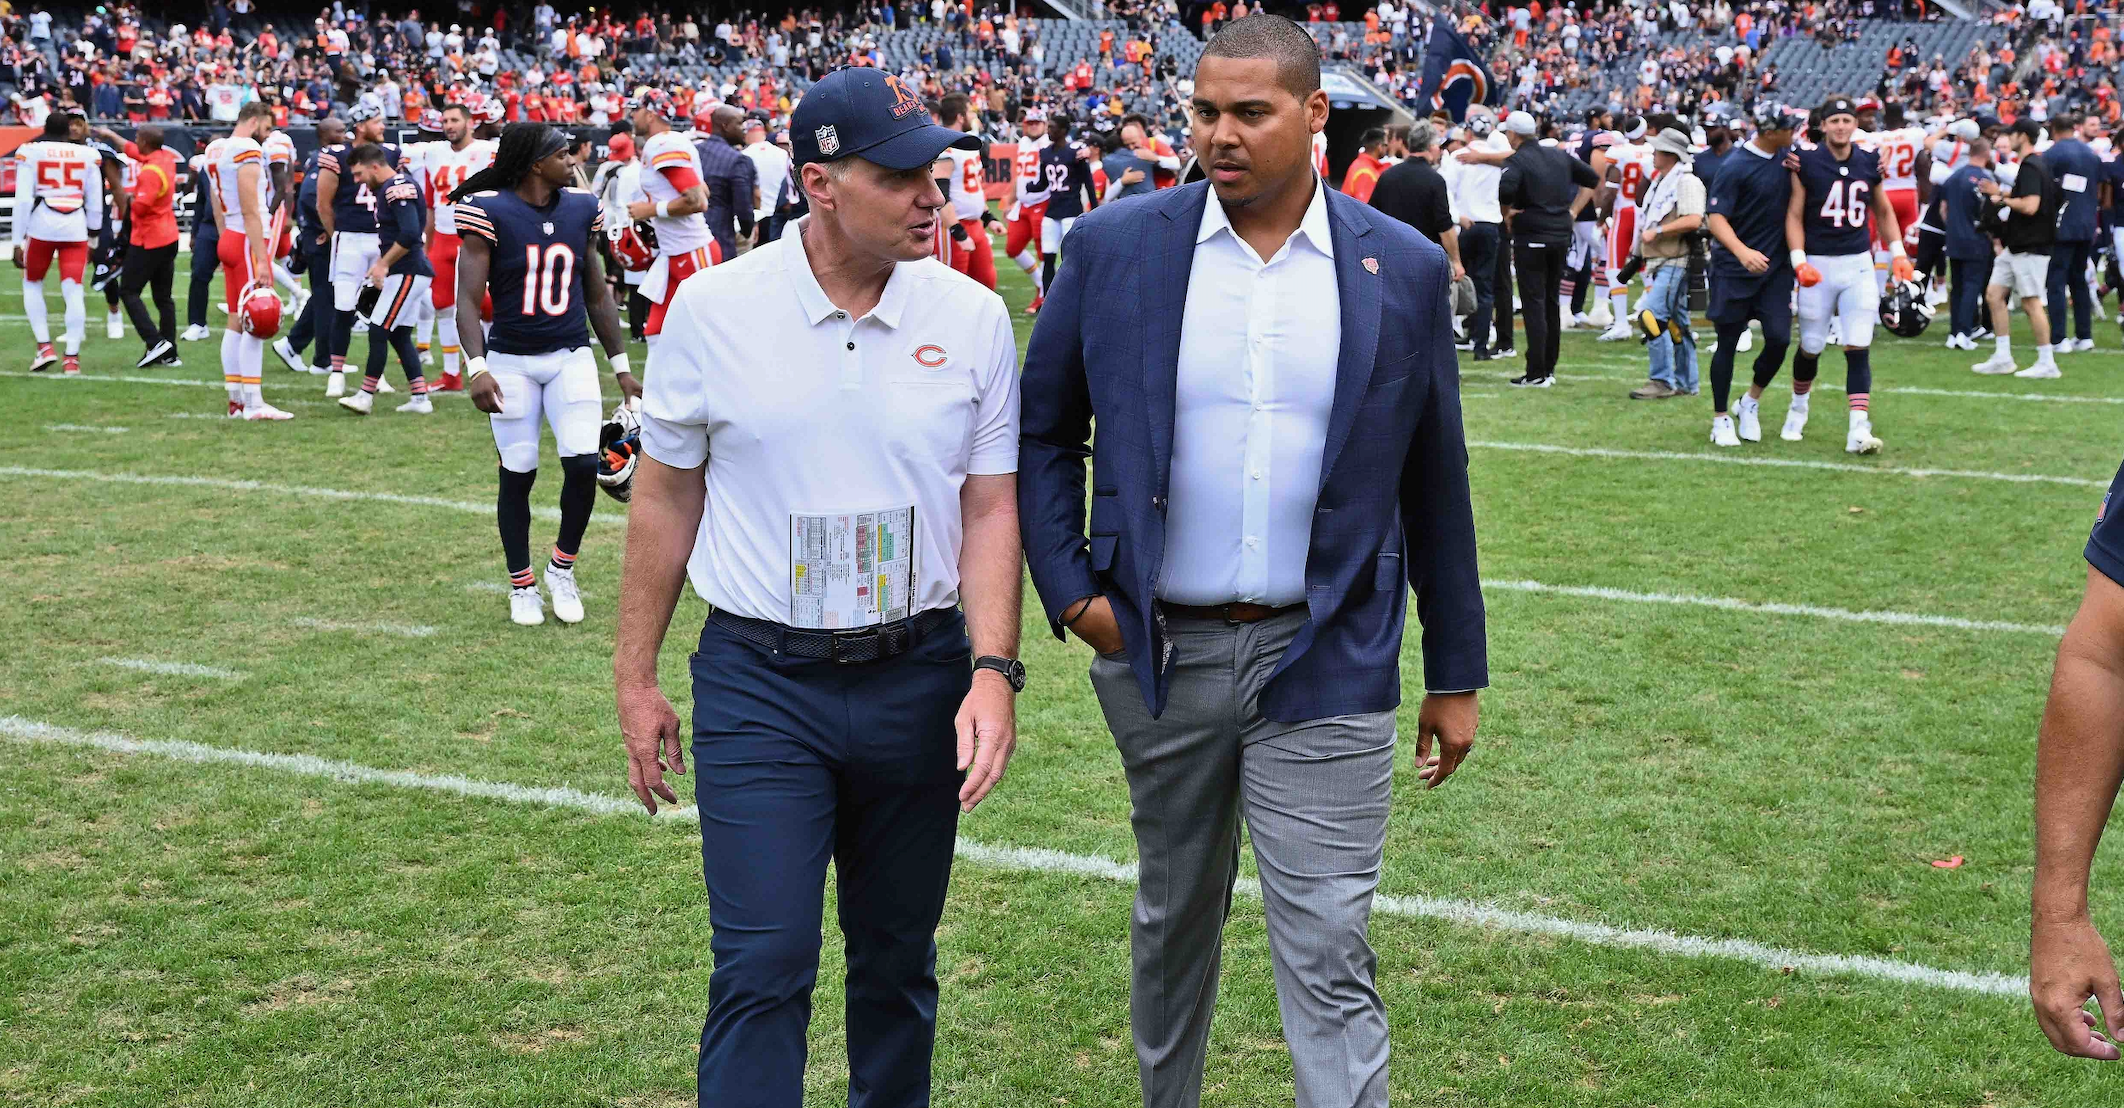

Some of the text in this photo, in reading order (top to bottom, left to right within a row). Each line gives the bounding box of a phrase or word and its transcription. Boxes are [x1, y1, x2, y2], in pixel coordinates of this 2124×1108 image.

[820, 136, 836, 151] NFL
[37, 160, 86, 190] 55
[1820, 179, 1869, 228] 46
[521, 242, 575, 317] 10
[911, 344, 948, 368] C
